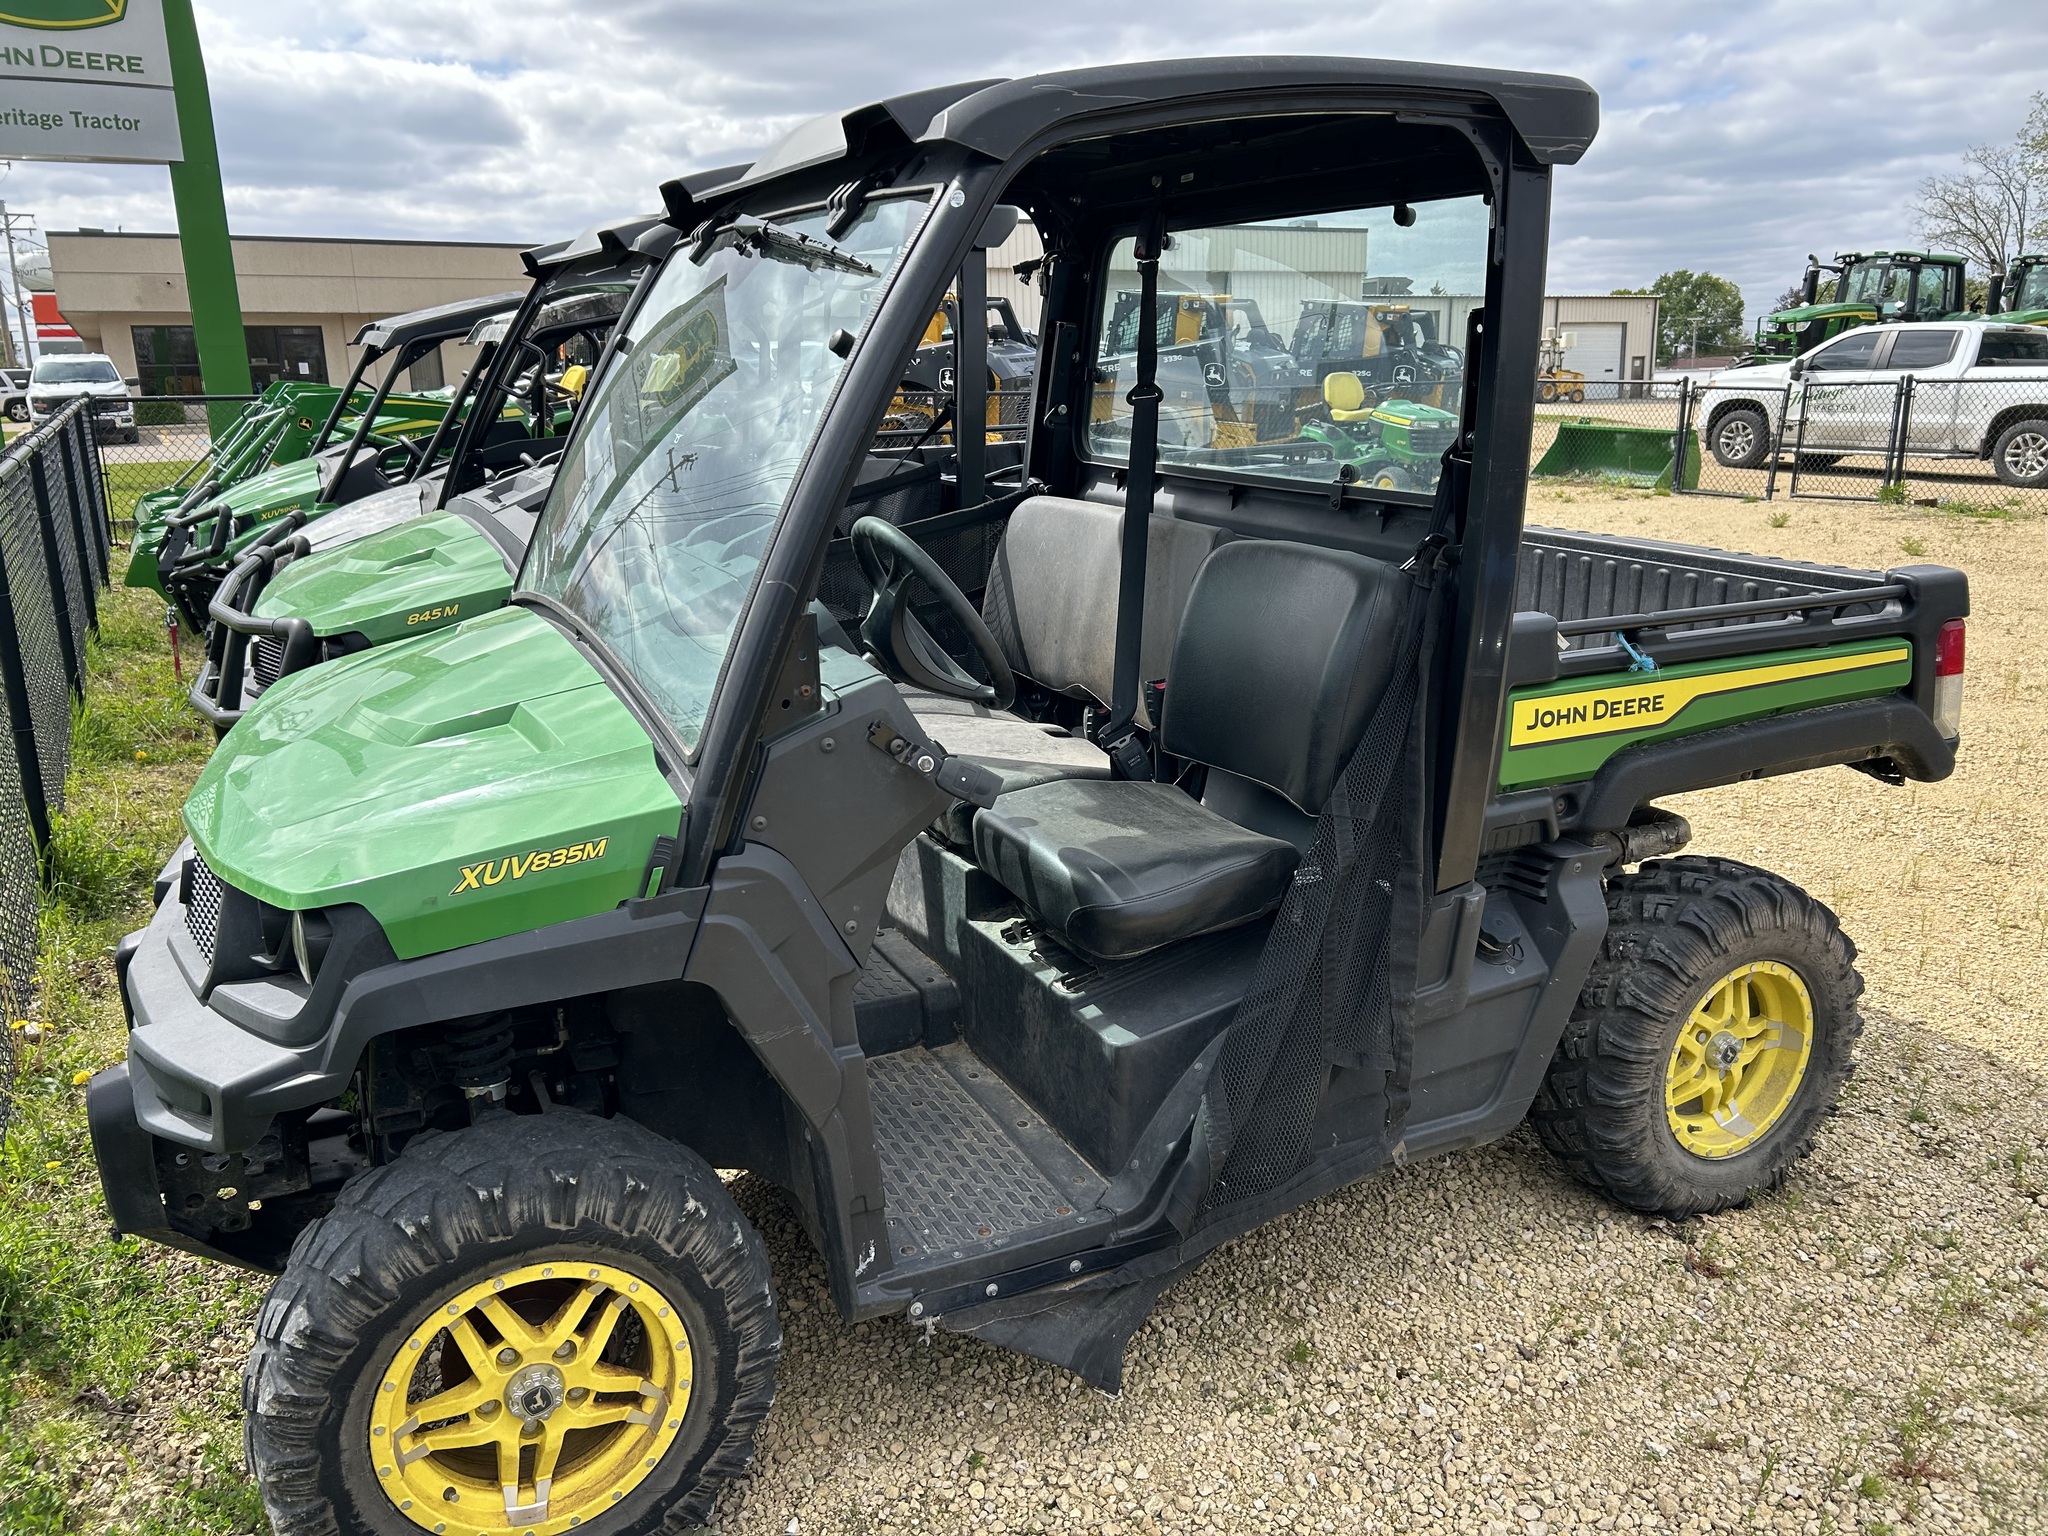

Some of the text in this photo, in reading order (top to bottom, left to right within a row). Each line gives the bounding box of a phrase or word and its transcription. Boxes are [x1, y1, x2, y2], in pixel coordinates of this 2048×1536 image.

[0, 45, 145, 74] HN DEERE
[0, 108, 140, 131] ritage Tractor
[1162, 355, 1183, 364] 333G
[261, 504, 300, 521] XUV590M
[1526, 694, 1665, 731] JOHN DEERE
[450, 837, 609, 896] XUV835M
